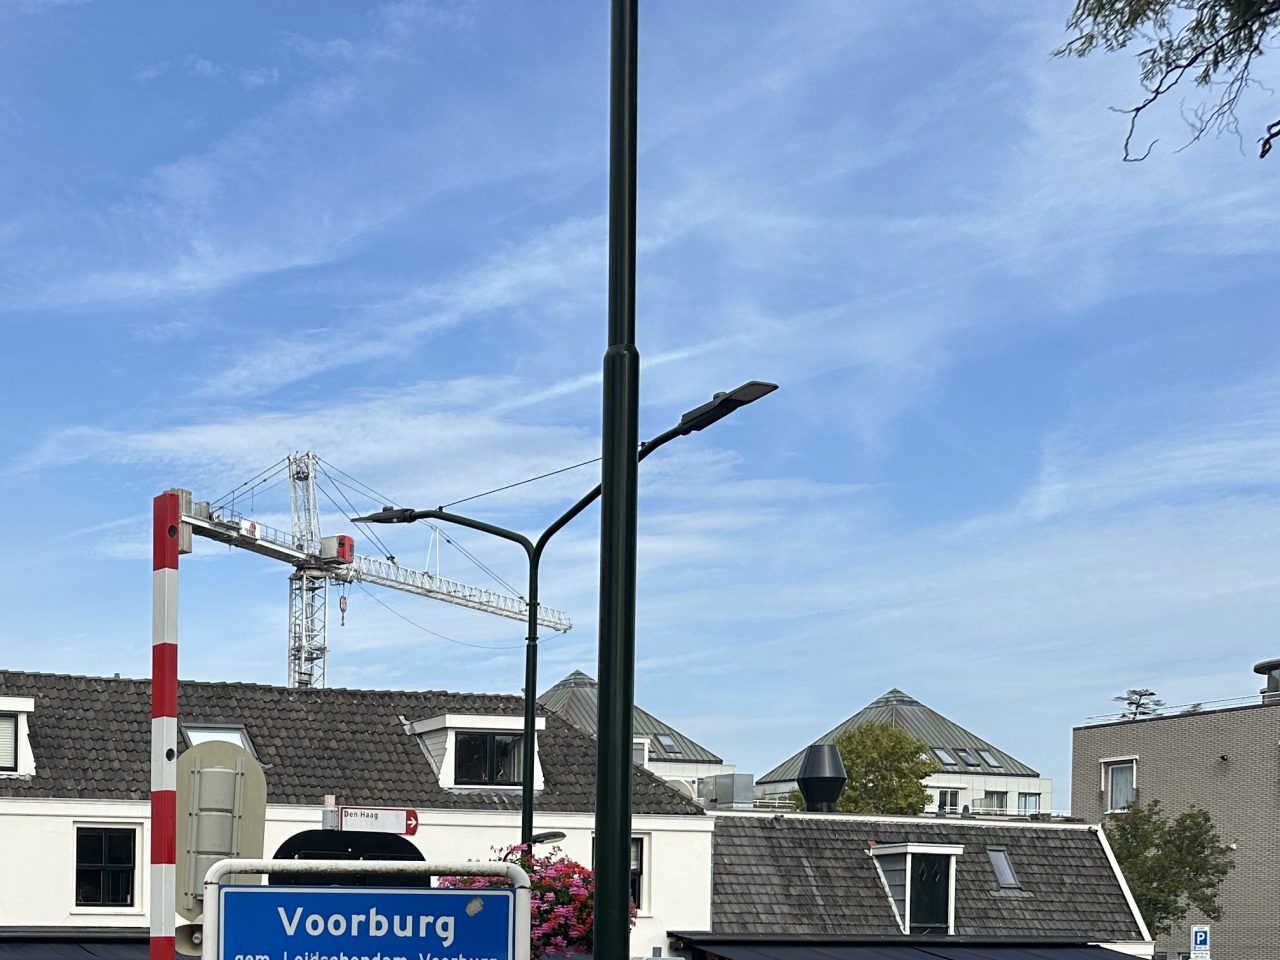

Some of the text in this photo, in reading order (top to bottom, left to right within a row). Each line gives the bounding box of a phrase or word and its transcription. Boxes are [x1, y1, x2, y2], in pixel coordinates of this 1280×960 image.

[344, 810, 379, 820] Den Haag
[277, 906, 456, 948] Voorburg
